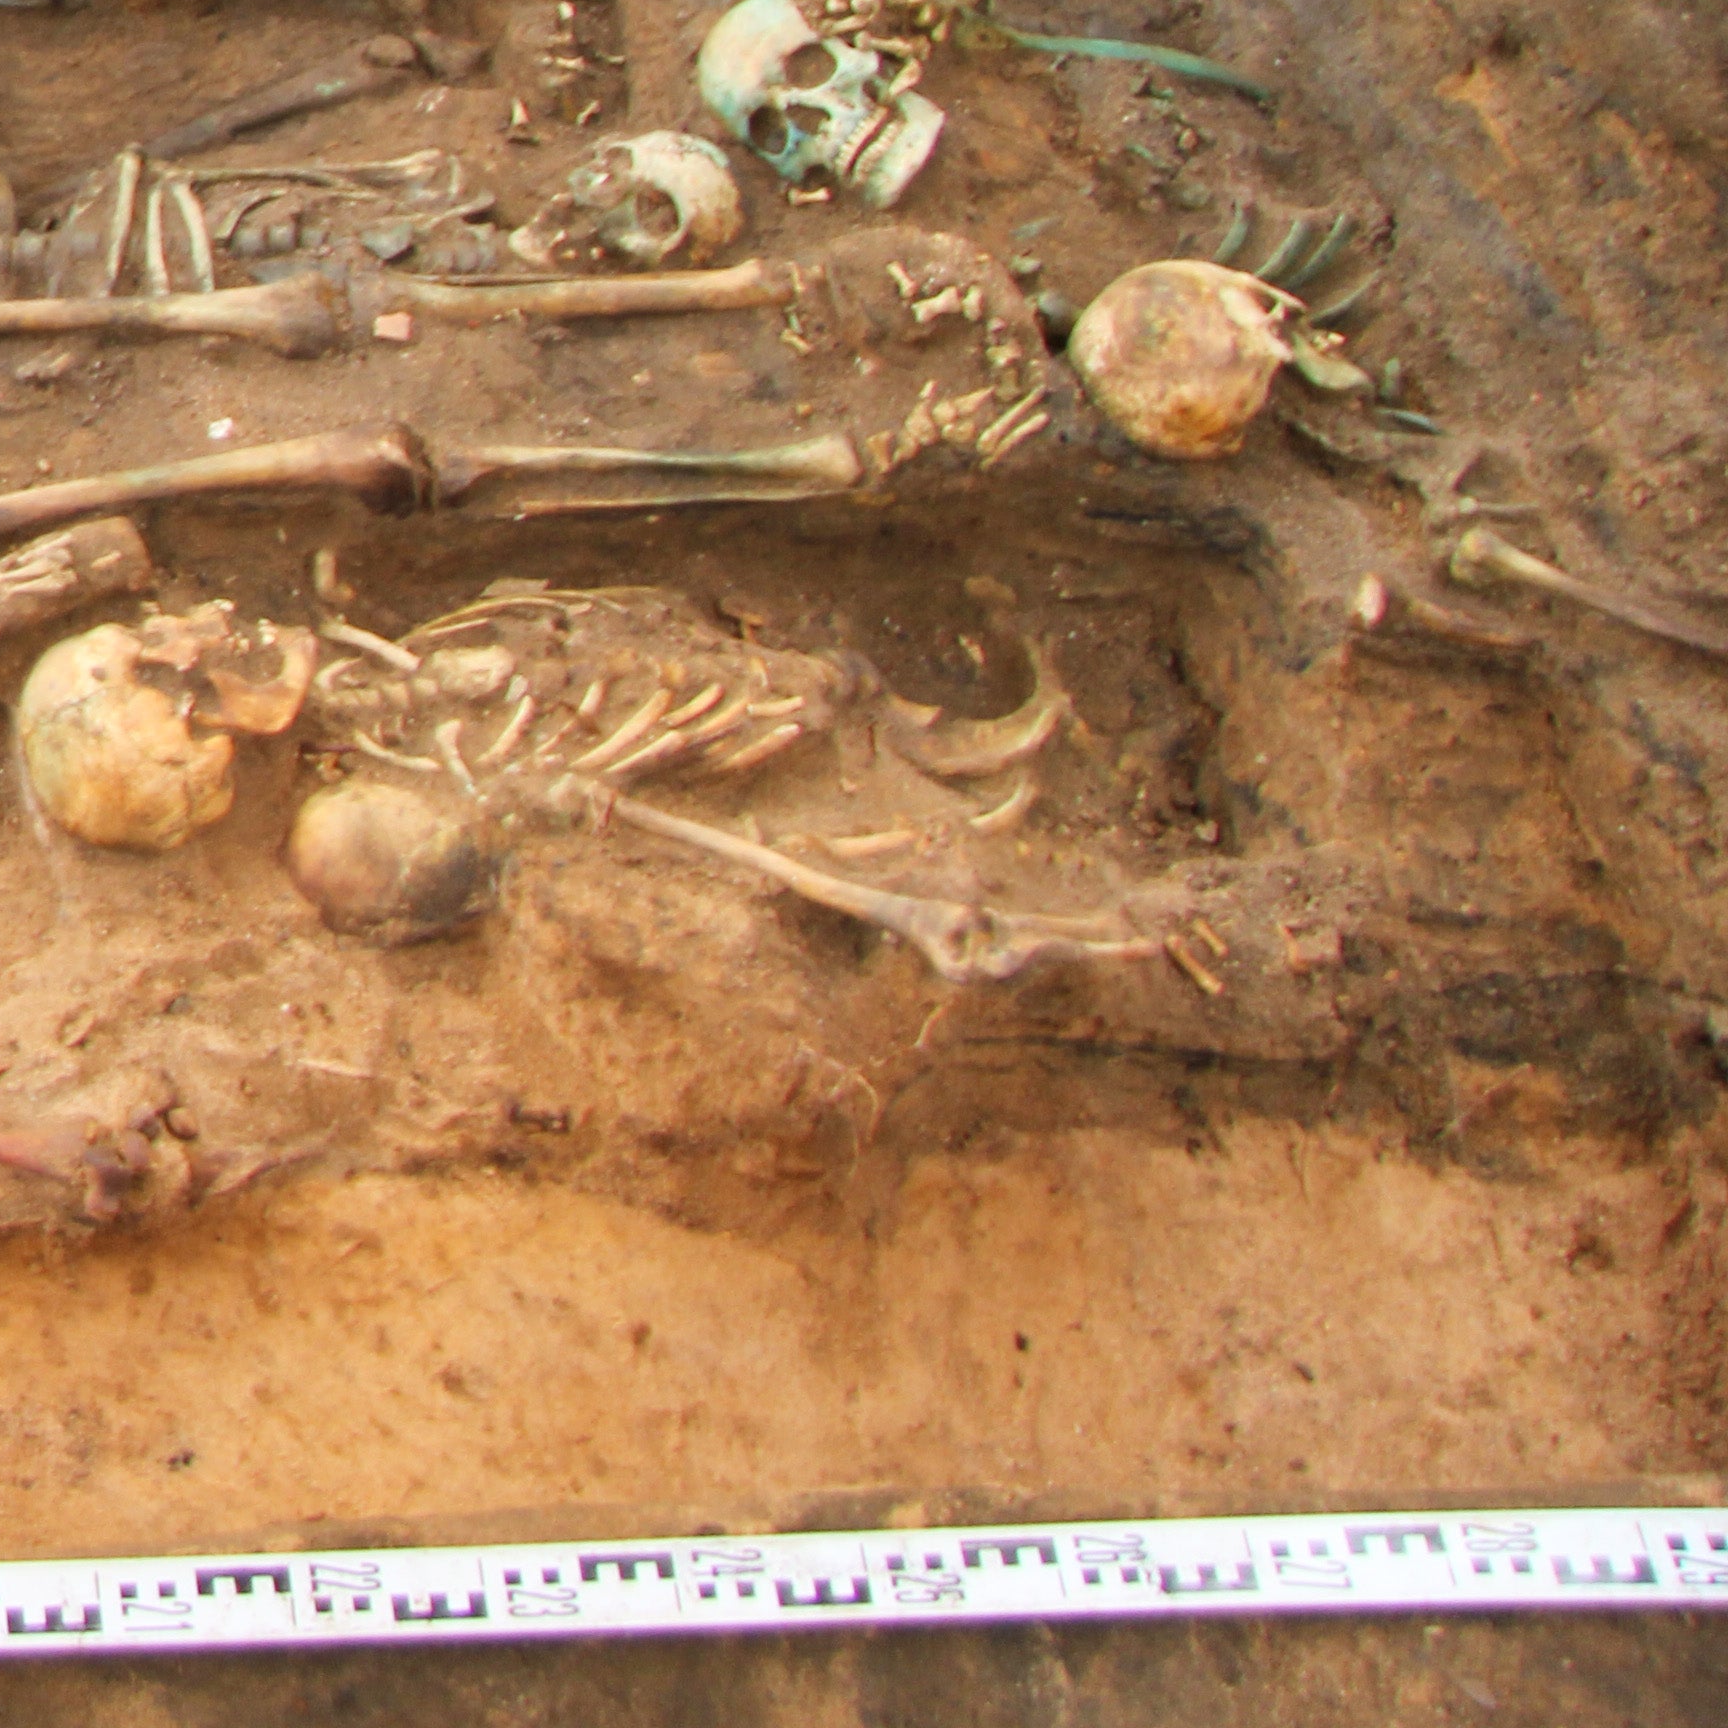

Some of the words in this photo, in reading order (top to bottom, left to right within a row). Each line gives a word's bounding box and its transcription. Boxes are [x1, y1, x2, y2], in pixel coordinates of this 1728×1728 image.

[1460, 1522, 1537, 1552] 28
[309, 1561, 381, 1595] 22
[692, 1547, 764, 1582] 24
[1275, 1560, 1353, 1590] 27
[508, 1584, 580, 1619] 23
[890, 1571, 963, 1606] 25
[120, 1597, 194, 1633] 21
